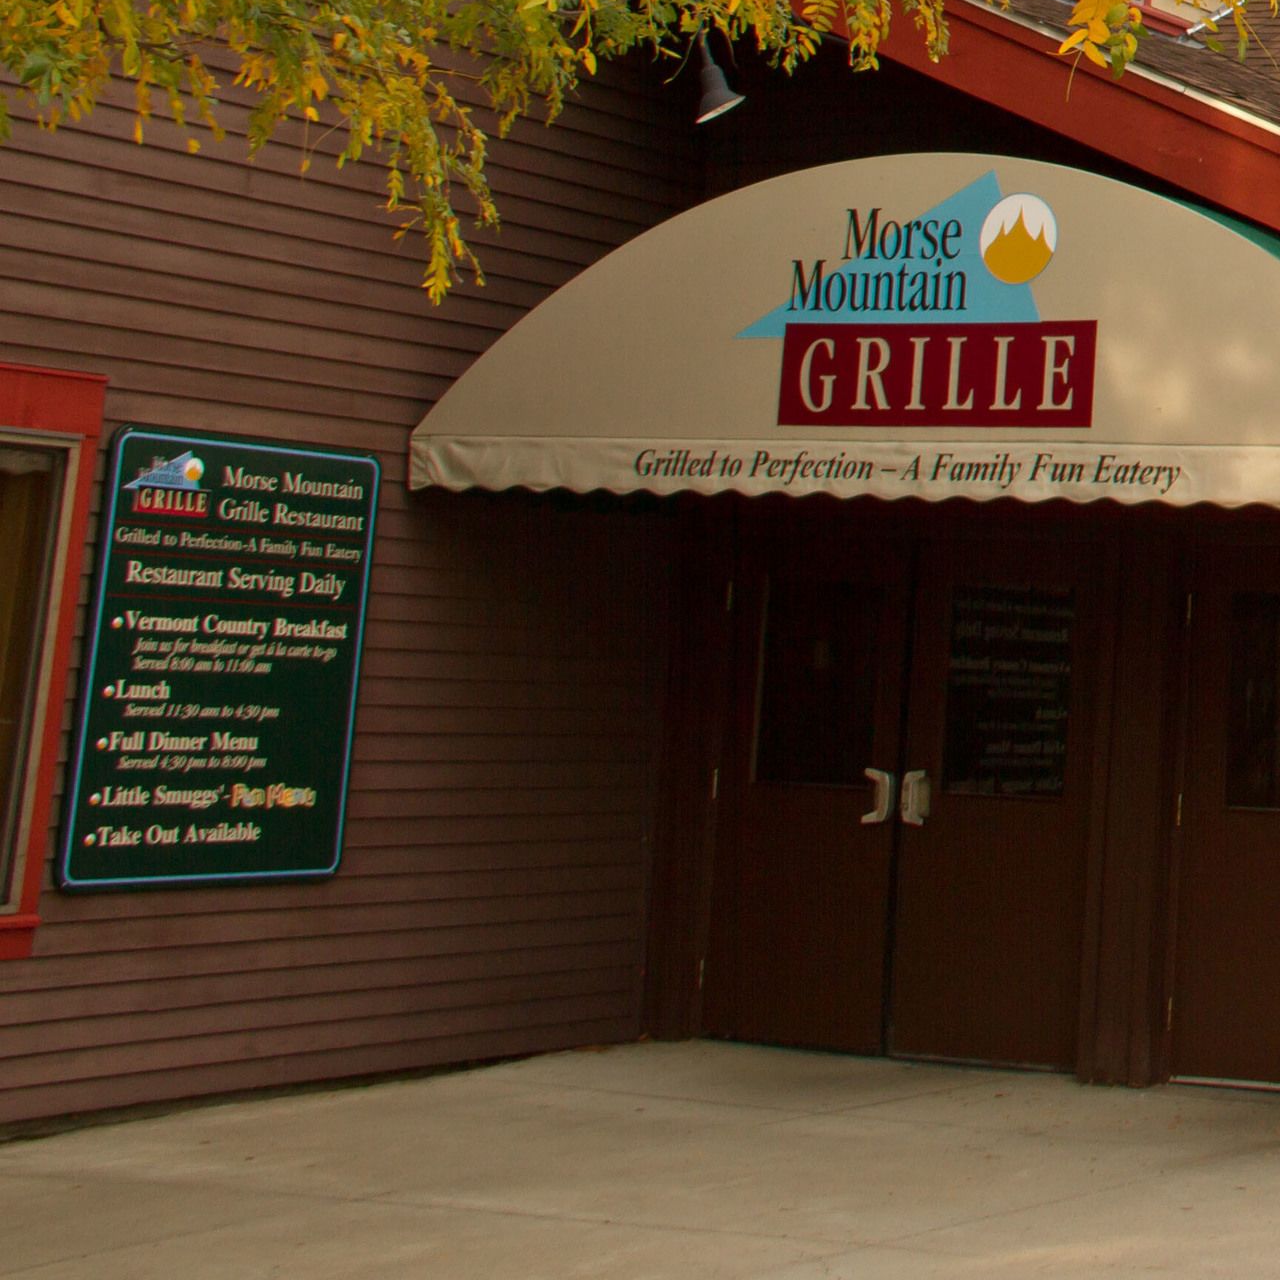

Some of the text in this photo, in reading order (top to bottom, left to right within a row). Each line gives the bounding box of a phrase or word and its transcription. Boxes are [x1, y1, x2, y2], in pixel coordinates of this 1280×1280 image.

[841, 207, 963, 260] Morse
[786, 257, 968, 312] Mountain
[799, 335, 1076, 413] GRILLE
[223, 466, 363, 500] Morse Mountain
[634, 448, 718, 478] Grilled
[719, 453, 743, 478] to
[747, 450, 874, 486] Perfection
[900, 454, 922, 481] A
[930, 453, 1022, 489] Family
[1028, 453, 1084, 483] Fun
[1092, 454, 1181, 494] Eatery
[140, 488, 208, 513] GRILLE
[219, 498, 363, 532] Grille Restaurant
[115, 527, 160, 546] Grilled
[165, 534, 177, 547] to
[259, 538, 298, 559] Family
[300, 541, 323, 557] Fun
[325, 544, 363, 563] Eatery
[126, 560, 347, 600] Restaurant Serving Daily
[125, 610, 348, 640] Vermont Country Breakfast
[132, 655, 169, 671] Served
[114, 679, 171, 699] Lunch
[124, 702, 166, 717] Served
[199, 706, 221, 718] am
[108, 731, 259, 751] Full Dinner Menu
[117, 754, 161, 769] Served
[101, 786, 150, 806] Little
[97, 822, 262, 846] Take Out Available
